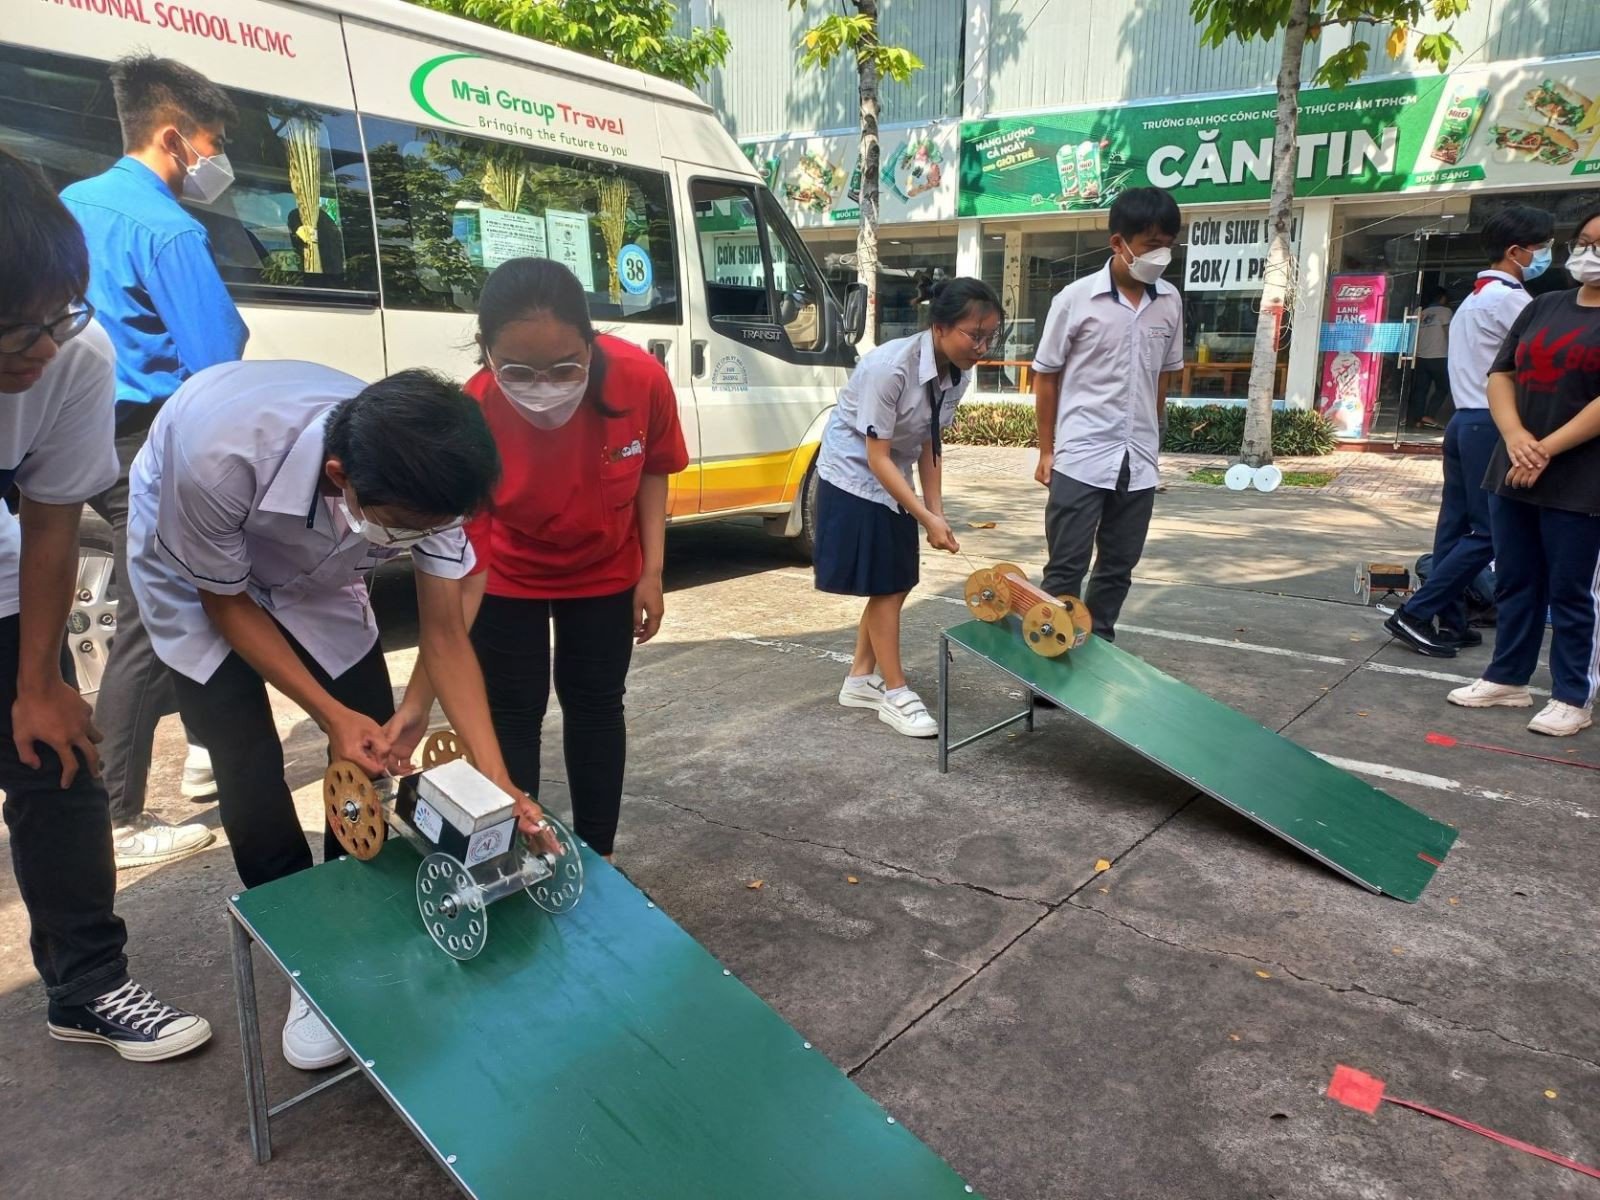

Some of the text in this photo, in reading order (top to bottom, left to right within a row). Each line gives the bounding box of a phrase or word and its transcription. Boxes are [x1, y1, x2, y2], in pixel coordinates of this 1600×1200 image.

[154, 2, 237, 44] SCHOOL
[239, 22, 296, 58] HCMC
[452, 79, 624, 135] Mai Group Travel
[1142, 117, 1185, 130] TRƯỜNG
[1186, 116, 1204, 128] ĐẠI
[1206, 114, 1228, 126] HỌC
[1230, 110, 1260, 122] CÔNG
[1305, 102, 1336, 116] THỰC
[1375, 95, 1418, 108] TPHCM
[478, 115, 628, 157] Bringing the future to you
[1146, 127, 1398, 188] CĂN TIN
[1191, 216, 1221, 246] CƠM
[1225, 220, 1259, 245] SINH
[626, 257, 645, 282] 38
[1189, 258, 1230, 288] 20K/
[741, 329, 782, 341] TRANSIT
